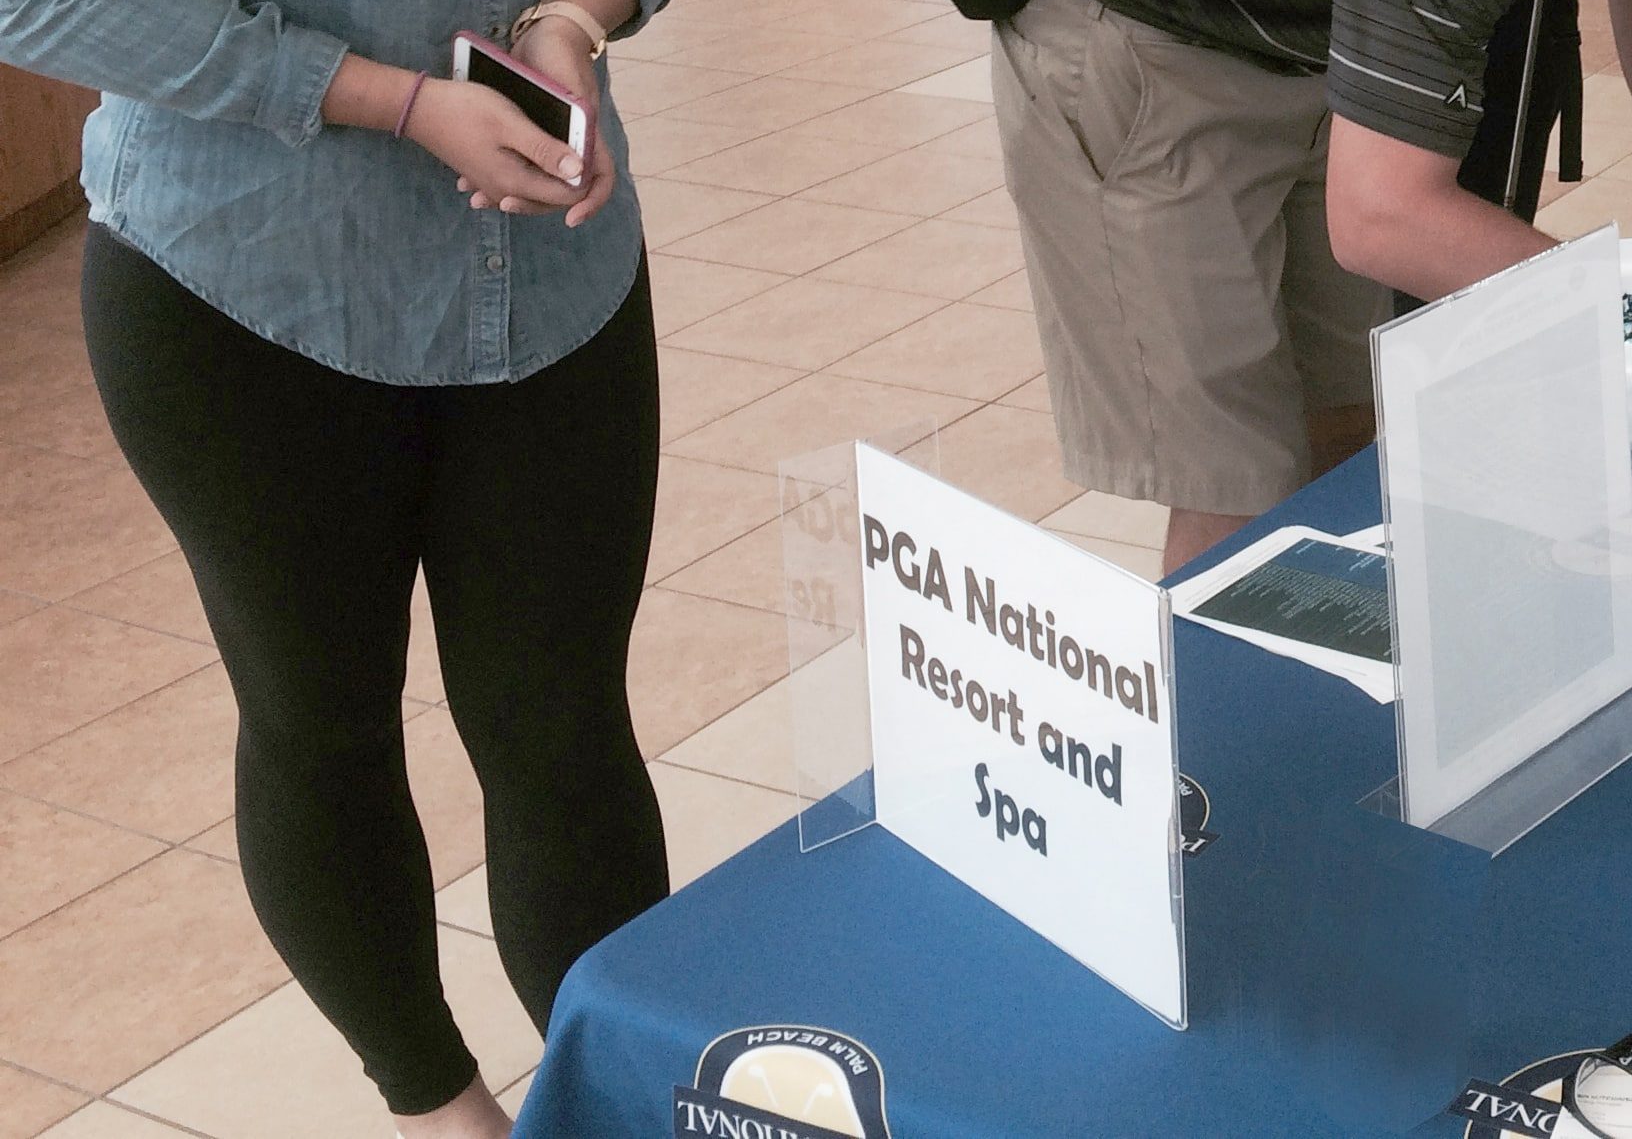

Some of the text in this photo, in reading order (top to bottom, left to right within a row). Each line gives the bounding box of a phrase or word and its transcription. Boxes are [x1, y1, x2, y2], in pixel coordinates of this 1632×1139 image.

[862, 512, 953, 614] PGA
[963, 566, 1160, 724] National
[899, 623, 1124, 807] Resort and
[974, 762, 1049, 857] Spa
[747, 1030, 870, 1077] PALM BEACH
